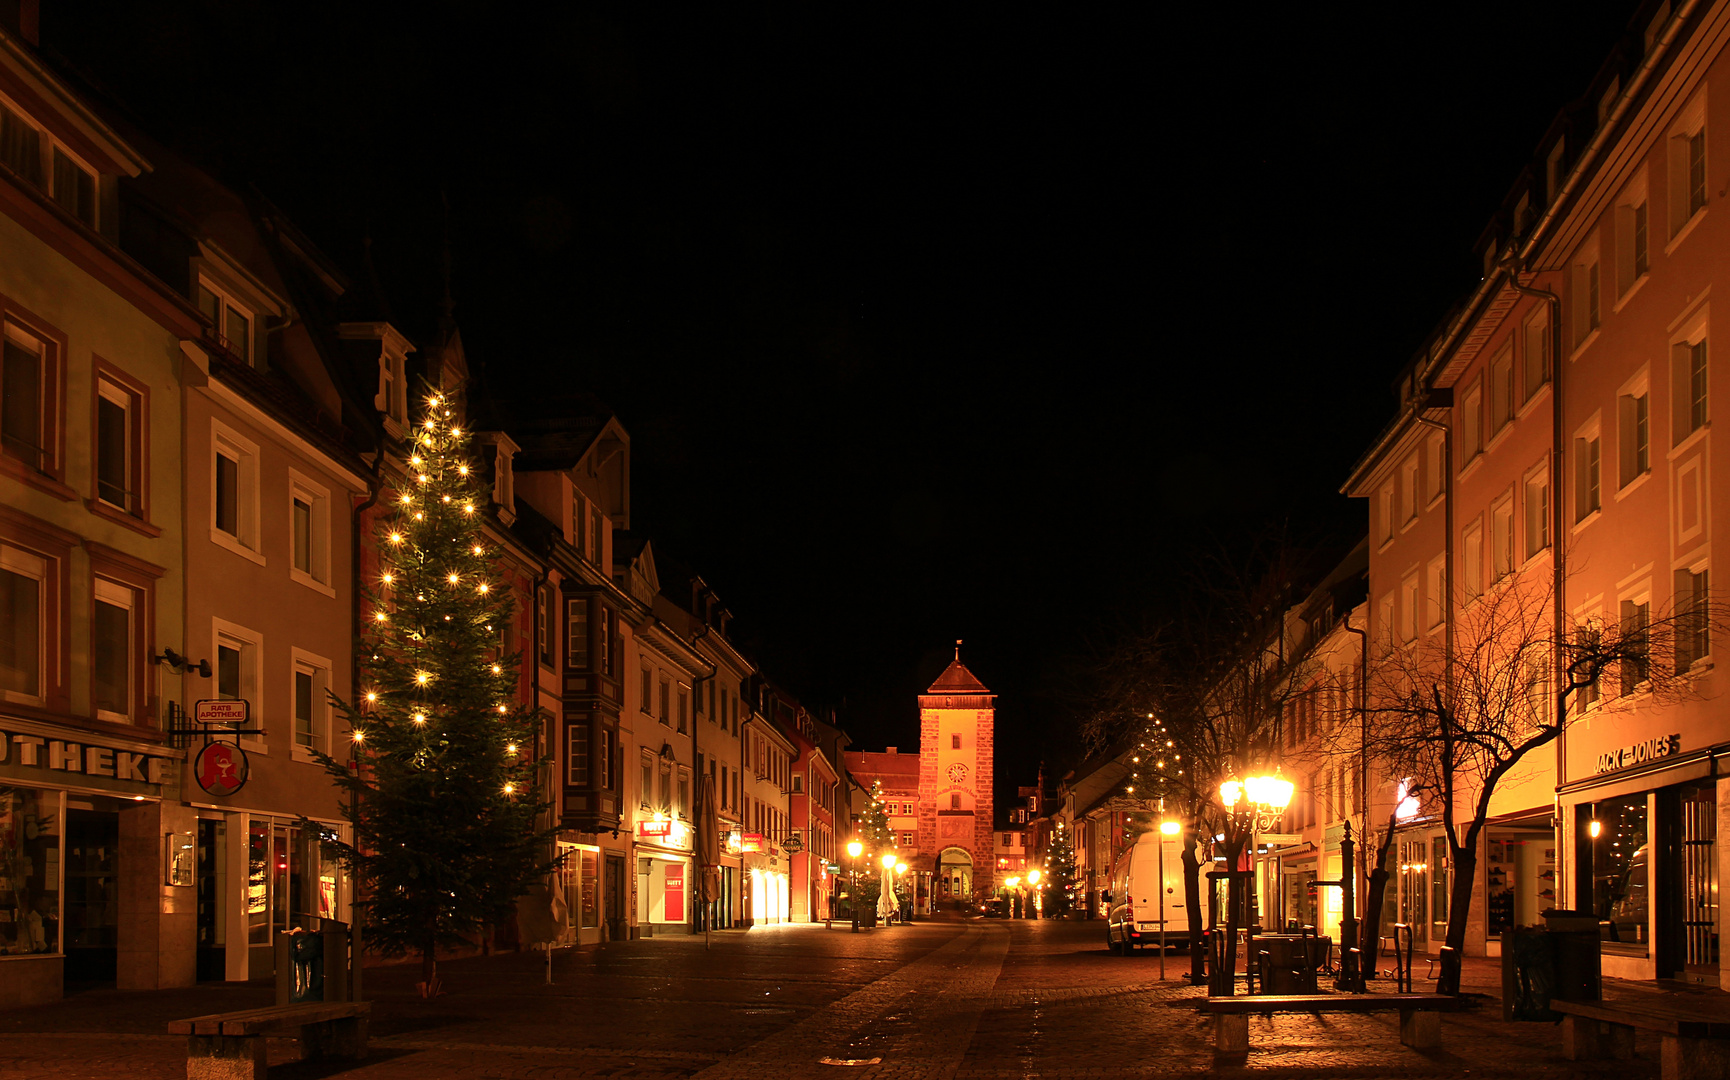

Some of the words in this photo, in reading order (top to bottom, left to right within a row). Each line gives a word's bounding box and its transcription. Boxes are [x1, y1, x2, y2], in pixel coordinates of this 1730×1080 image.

[1593, 749, 1621, 774] JACK
[1632, 734, 1672, 765] JONES
[643, 822, 668, 832] WITT
